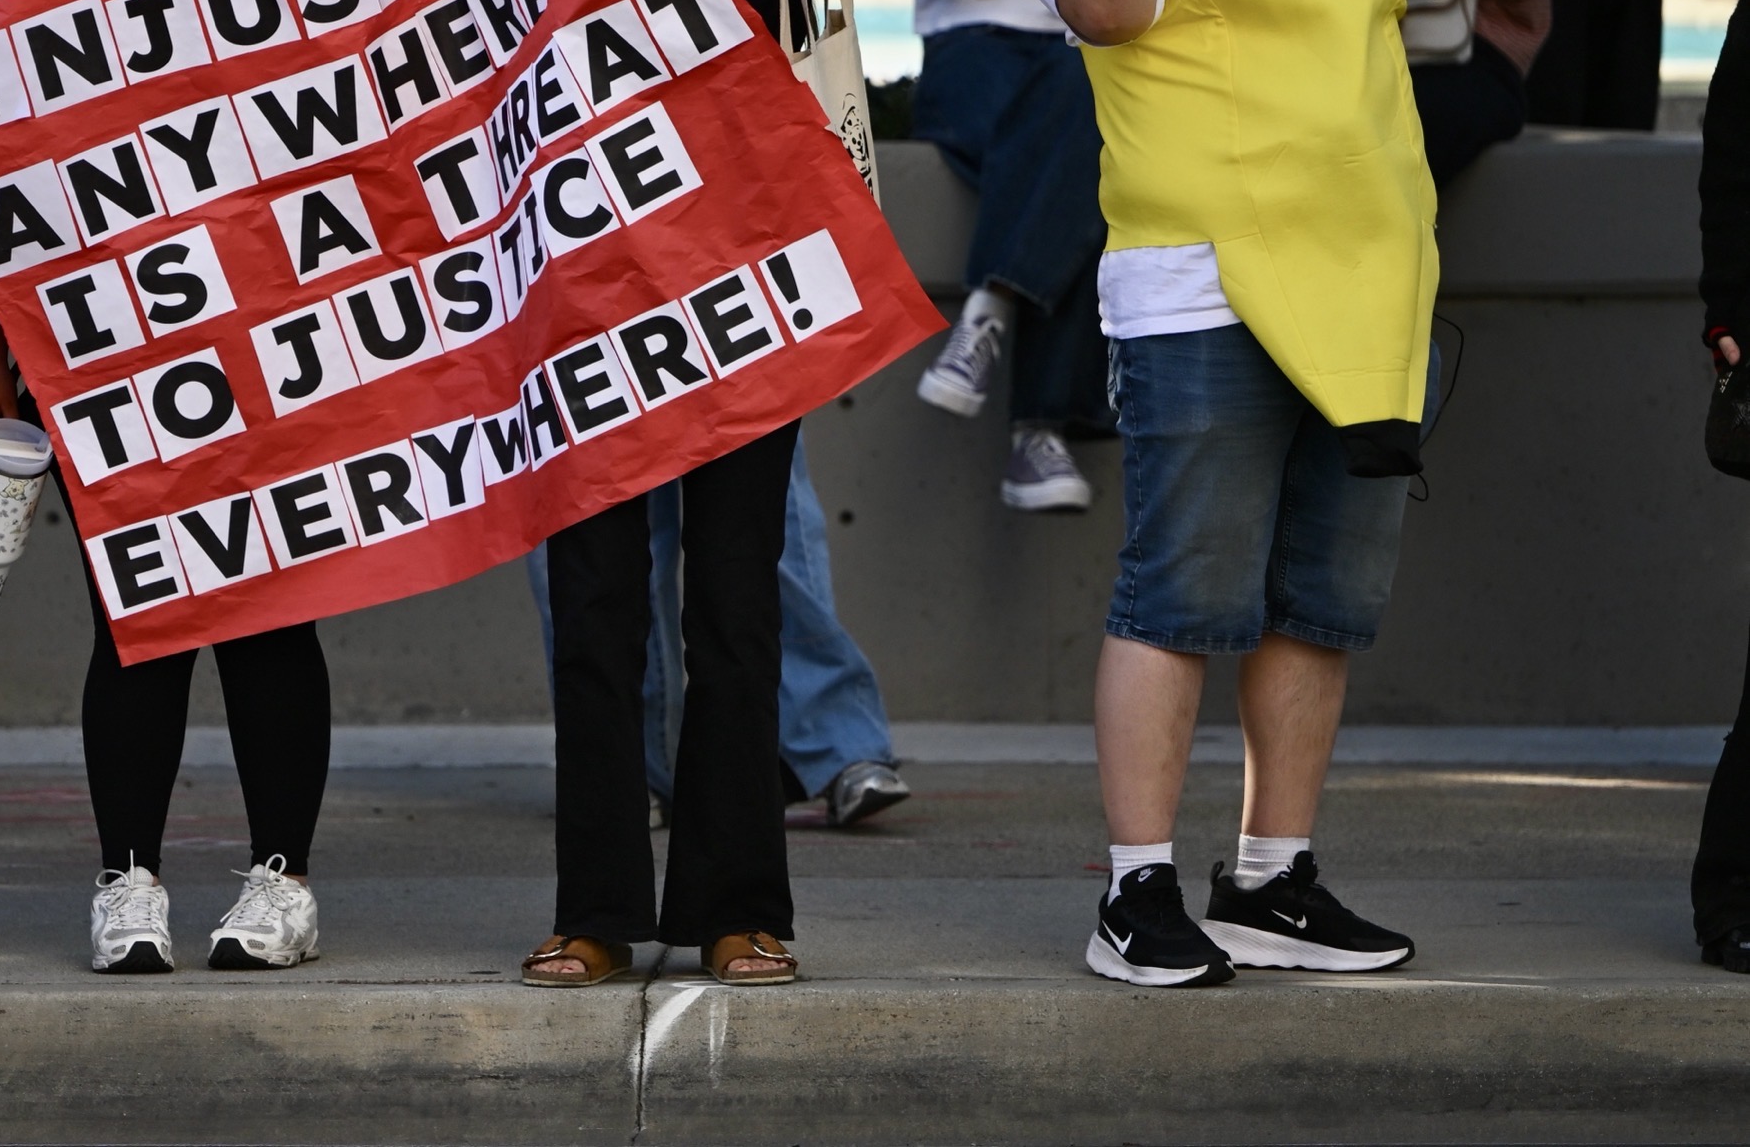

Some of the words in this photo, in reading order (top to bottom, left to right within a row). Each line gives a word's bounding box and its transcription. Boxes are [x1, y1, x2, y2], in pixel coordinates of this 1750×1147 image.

[51, 242, 207, 358] IS
[299, 190, 372, 273] A
[63, 362, 234, 469] TO
[273, 115, 681, 400] JUSTICE
[102, 250, 813, 610] EVERYWHERE!
